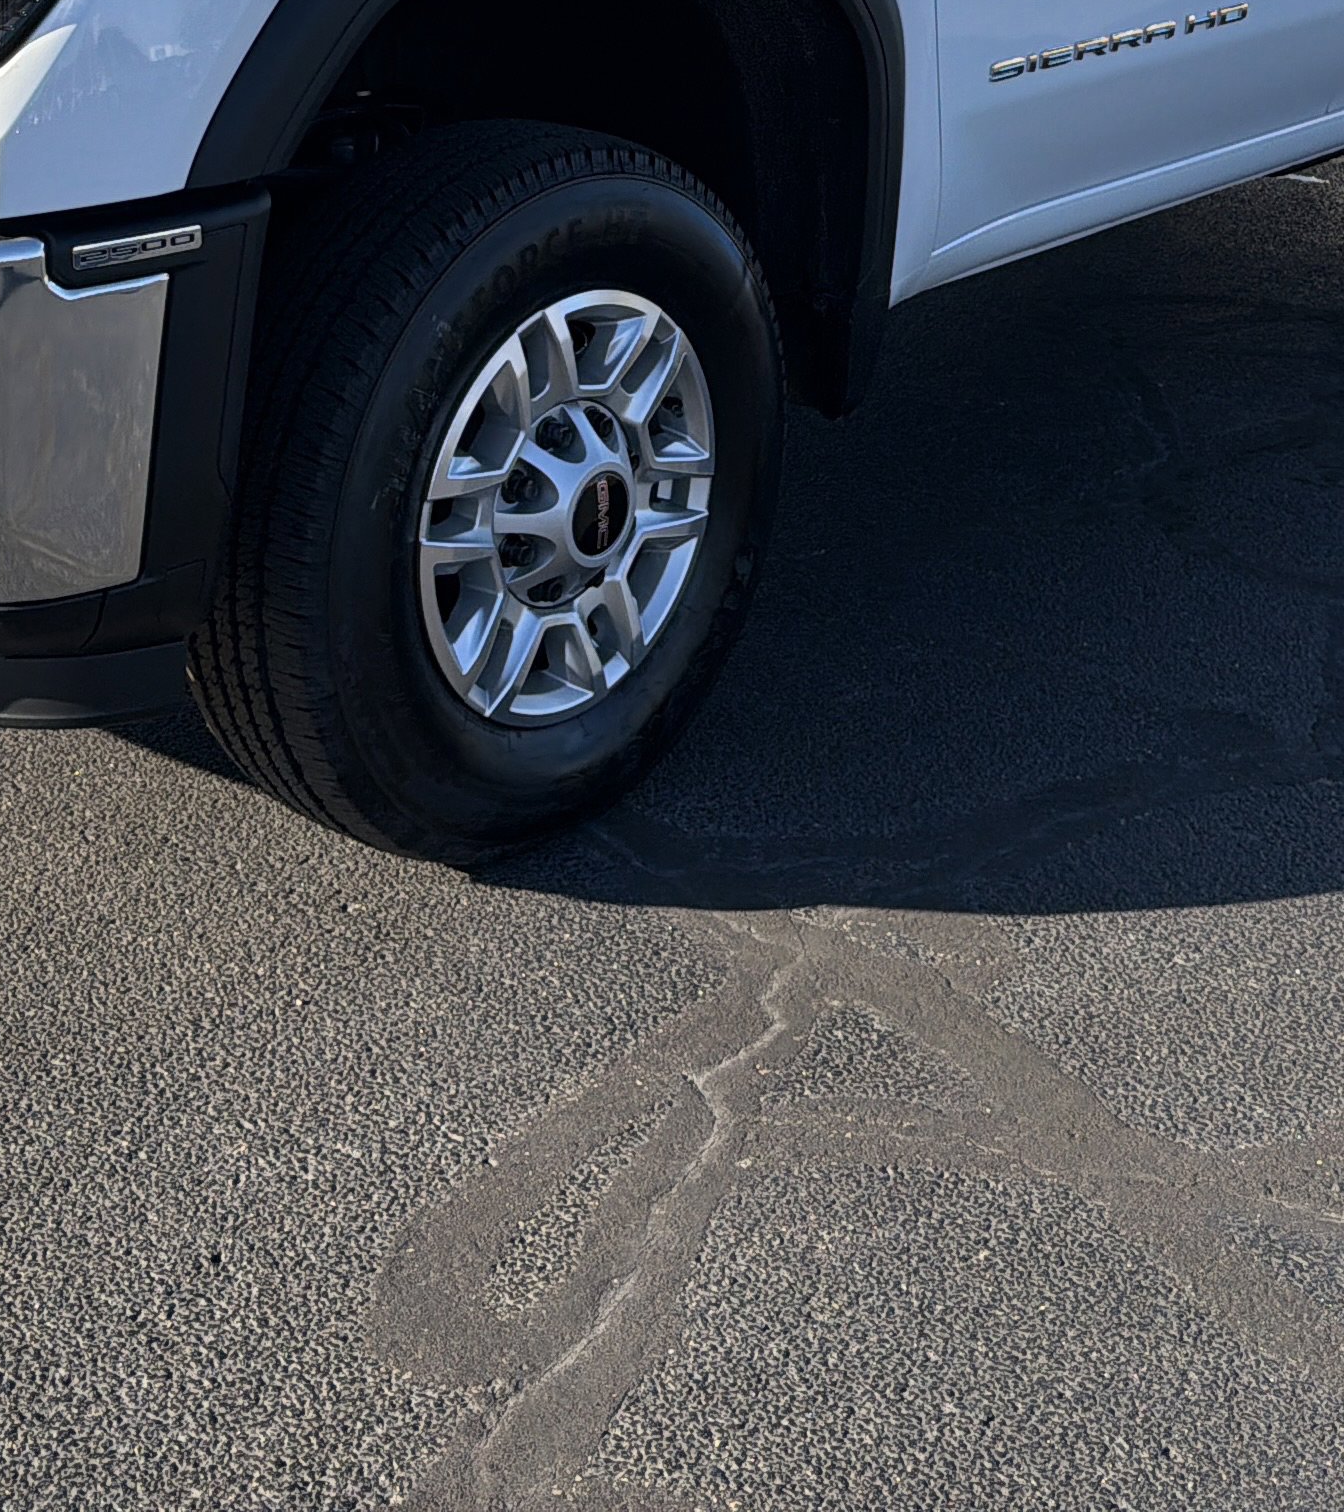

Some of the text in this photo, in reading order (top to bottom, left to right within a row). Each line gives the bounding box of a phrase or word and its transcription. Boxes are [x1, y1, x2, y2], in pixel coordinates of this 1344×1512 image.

[987, 0, 1249, 82] SIERRA HD
[79, 231, 196, 265] 2500
[596, 478, 610, 550] GMC
